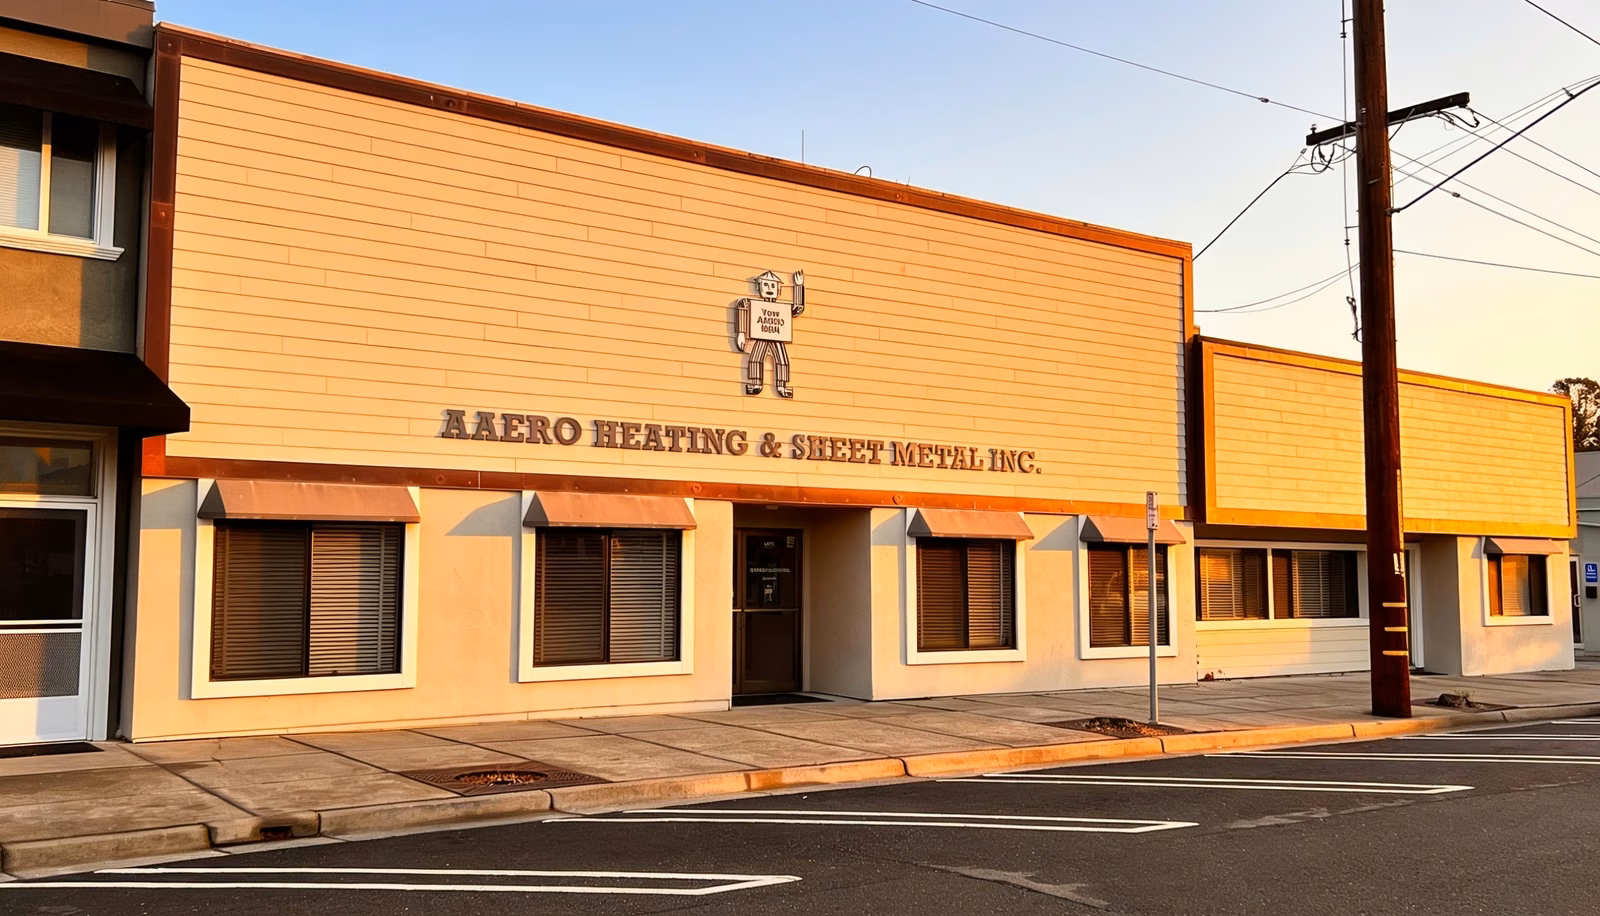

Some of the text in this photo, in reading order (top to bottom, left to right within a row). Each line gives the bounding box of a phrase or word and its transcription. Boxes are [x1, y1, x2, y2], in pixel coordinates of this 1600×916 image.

[441, 409, 1042, 475] AAERO HEATING & SHEET METAL INC.
